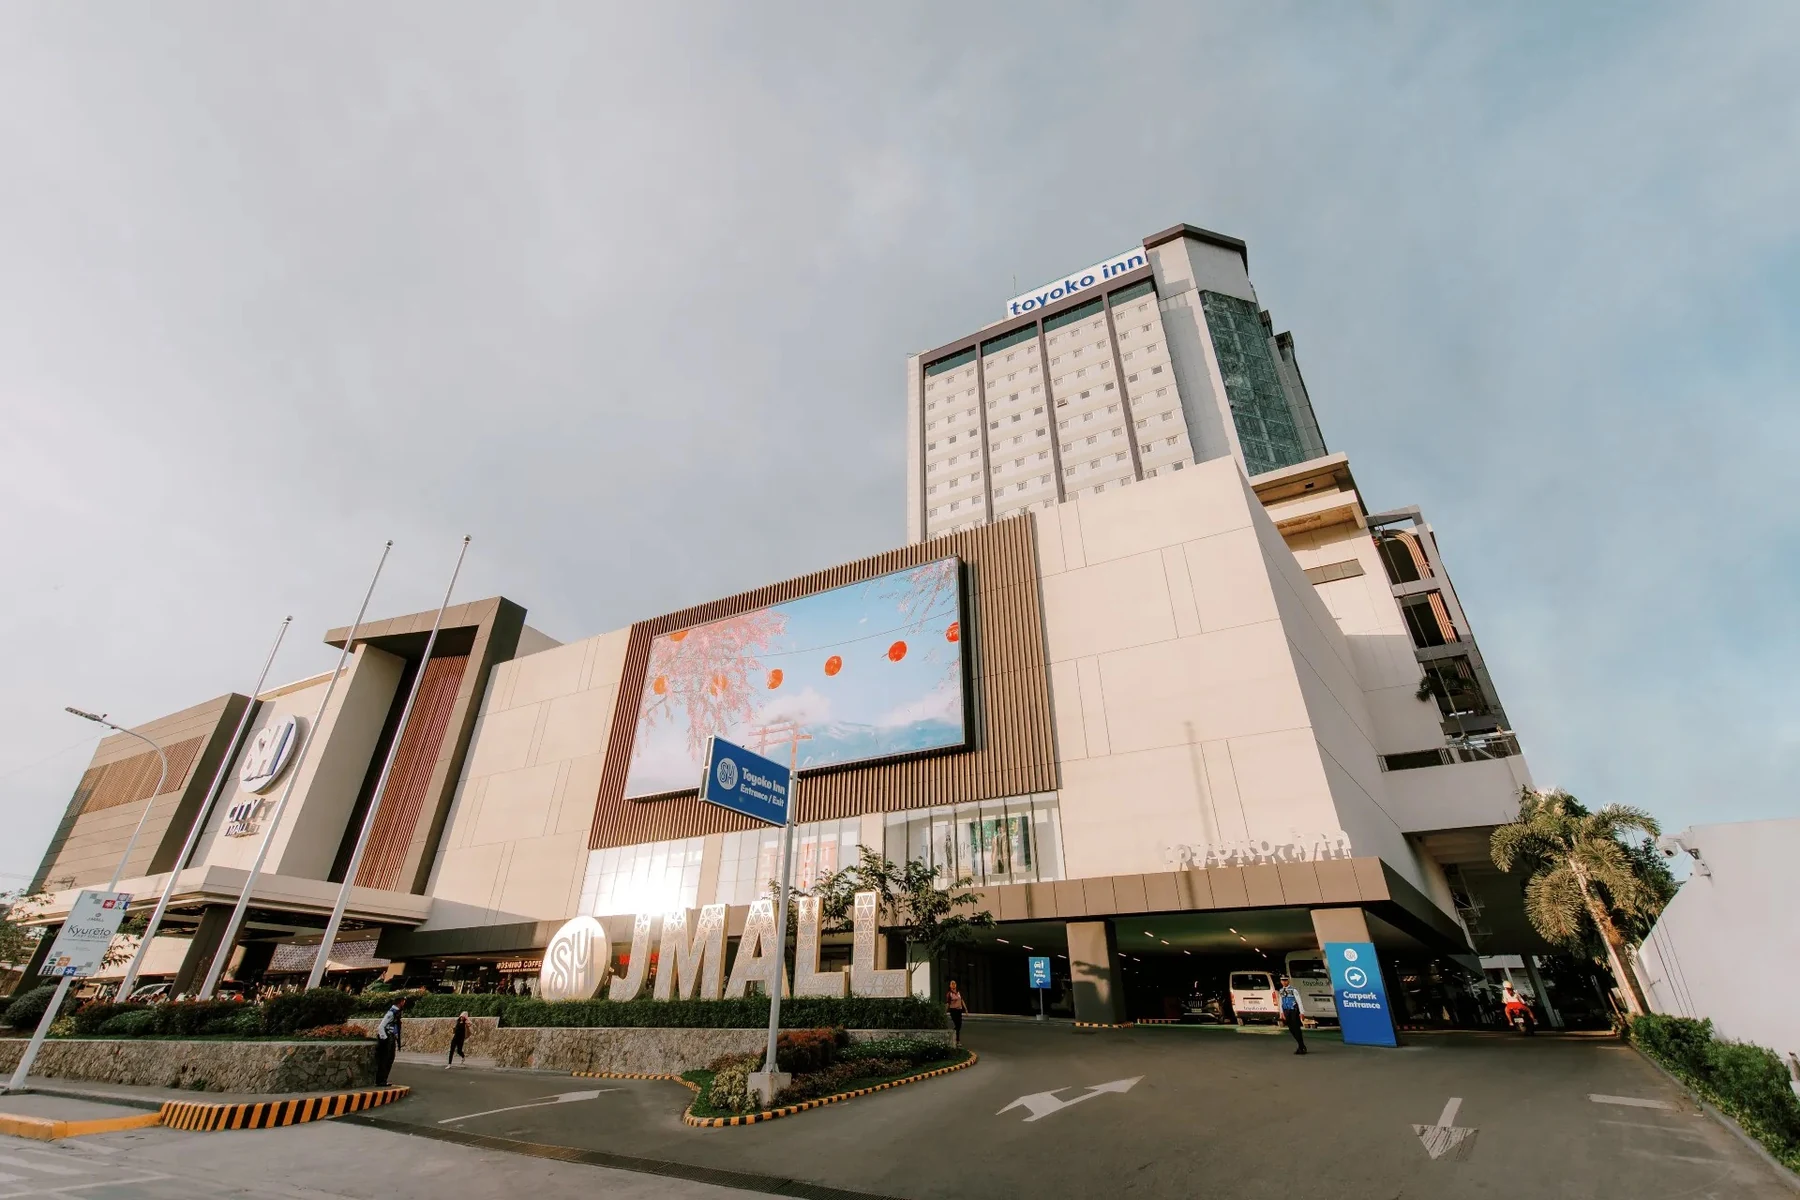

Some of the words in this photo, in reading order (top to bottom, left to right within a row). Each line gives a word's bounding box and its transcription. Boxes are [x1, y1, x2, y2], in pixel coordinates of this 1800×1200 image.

[1010, 275, 1095, 316] toyoko
[1102, 254, 1143, 279] inn
[742, 767, 772, 789] Toyoko
[772, 780, 785, 796] Inn
[740, 784, 768, 801] Entrance
[772, 796, 785, 808] Exit
[229, 798, 266, 823] CITY
[608, 892, 910, 1000] JMALL
[523, 960, 542, 968] COFFE
[1343, 991, 1377, 1001] Carpark
[1343, 1000, 1381, 1009] Entrance
